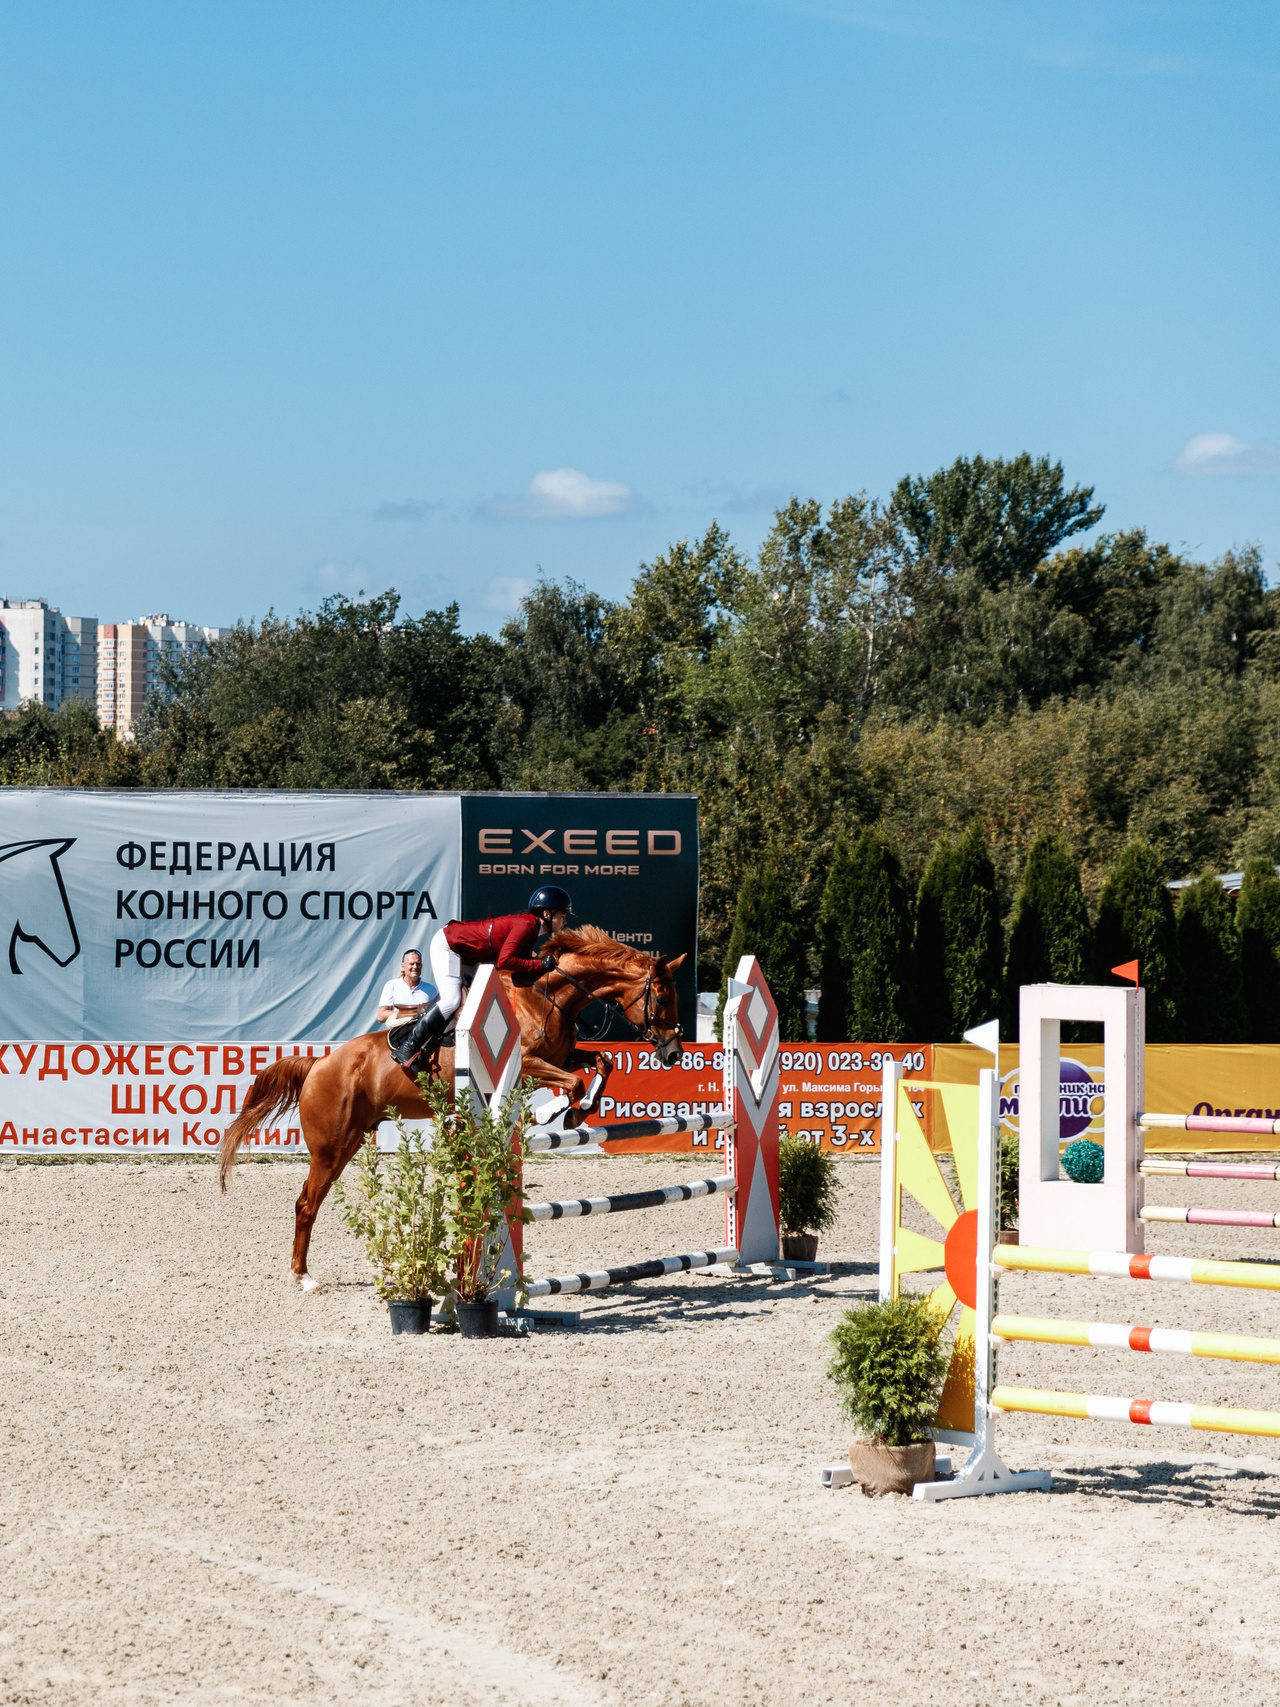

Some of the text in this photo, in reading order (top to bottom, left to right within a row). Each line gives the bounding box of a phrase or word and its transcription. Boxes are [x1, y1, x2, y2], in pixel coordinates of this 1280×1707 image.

[478, 828, 682, 856] EXEED
[116, 840, 337, 876] ФЕДЕРАЦИЯ
[478, 864, 640, 876] BORN FOR MORE
[116, 890, 438, 920] КОННОГО СПОРТА
[114, 938, 261, 969] РОССИИ
[111, 1083, 256, 1115] ШКОЛ
[782, 1083, 799, 1094] ул.
[802, 1082, 851, 1093] Максима
[599, 1097, 725, 1119] Рисовани
[830, 1124, 875, 1146] 3-х
